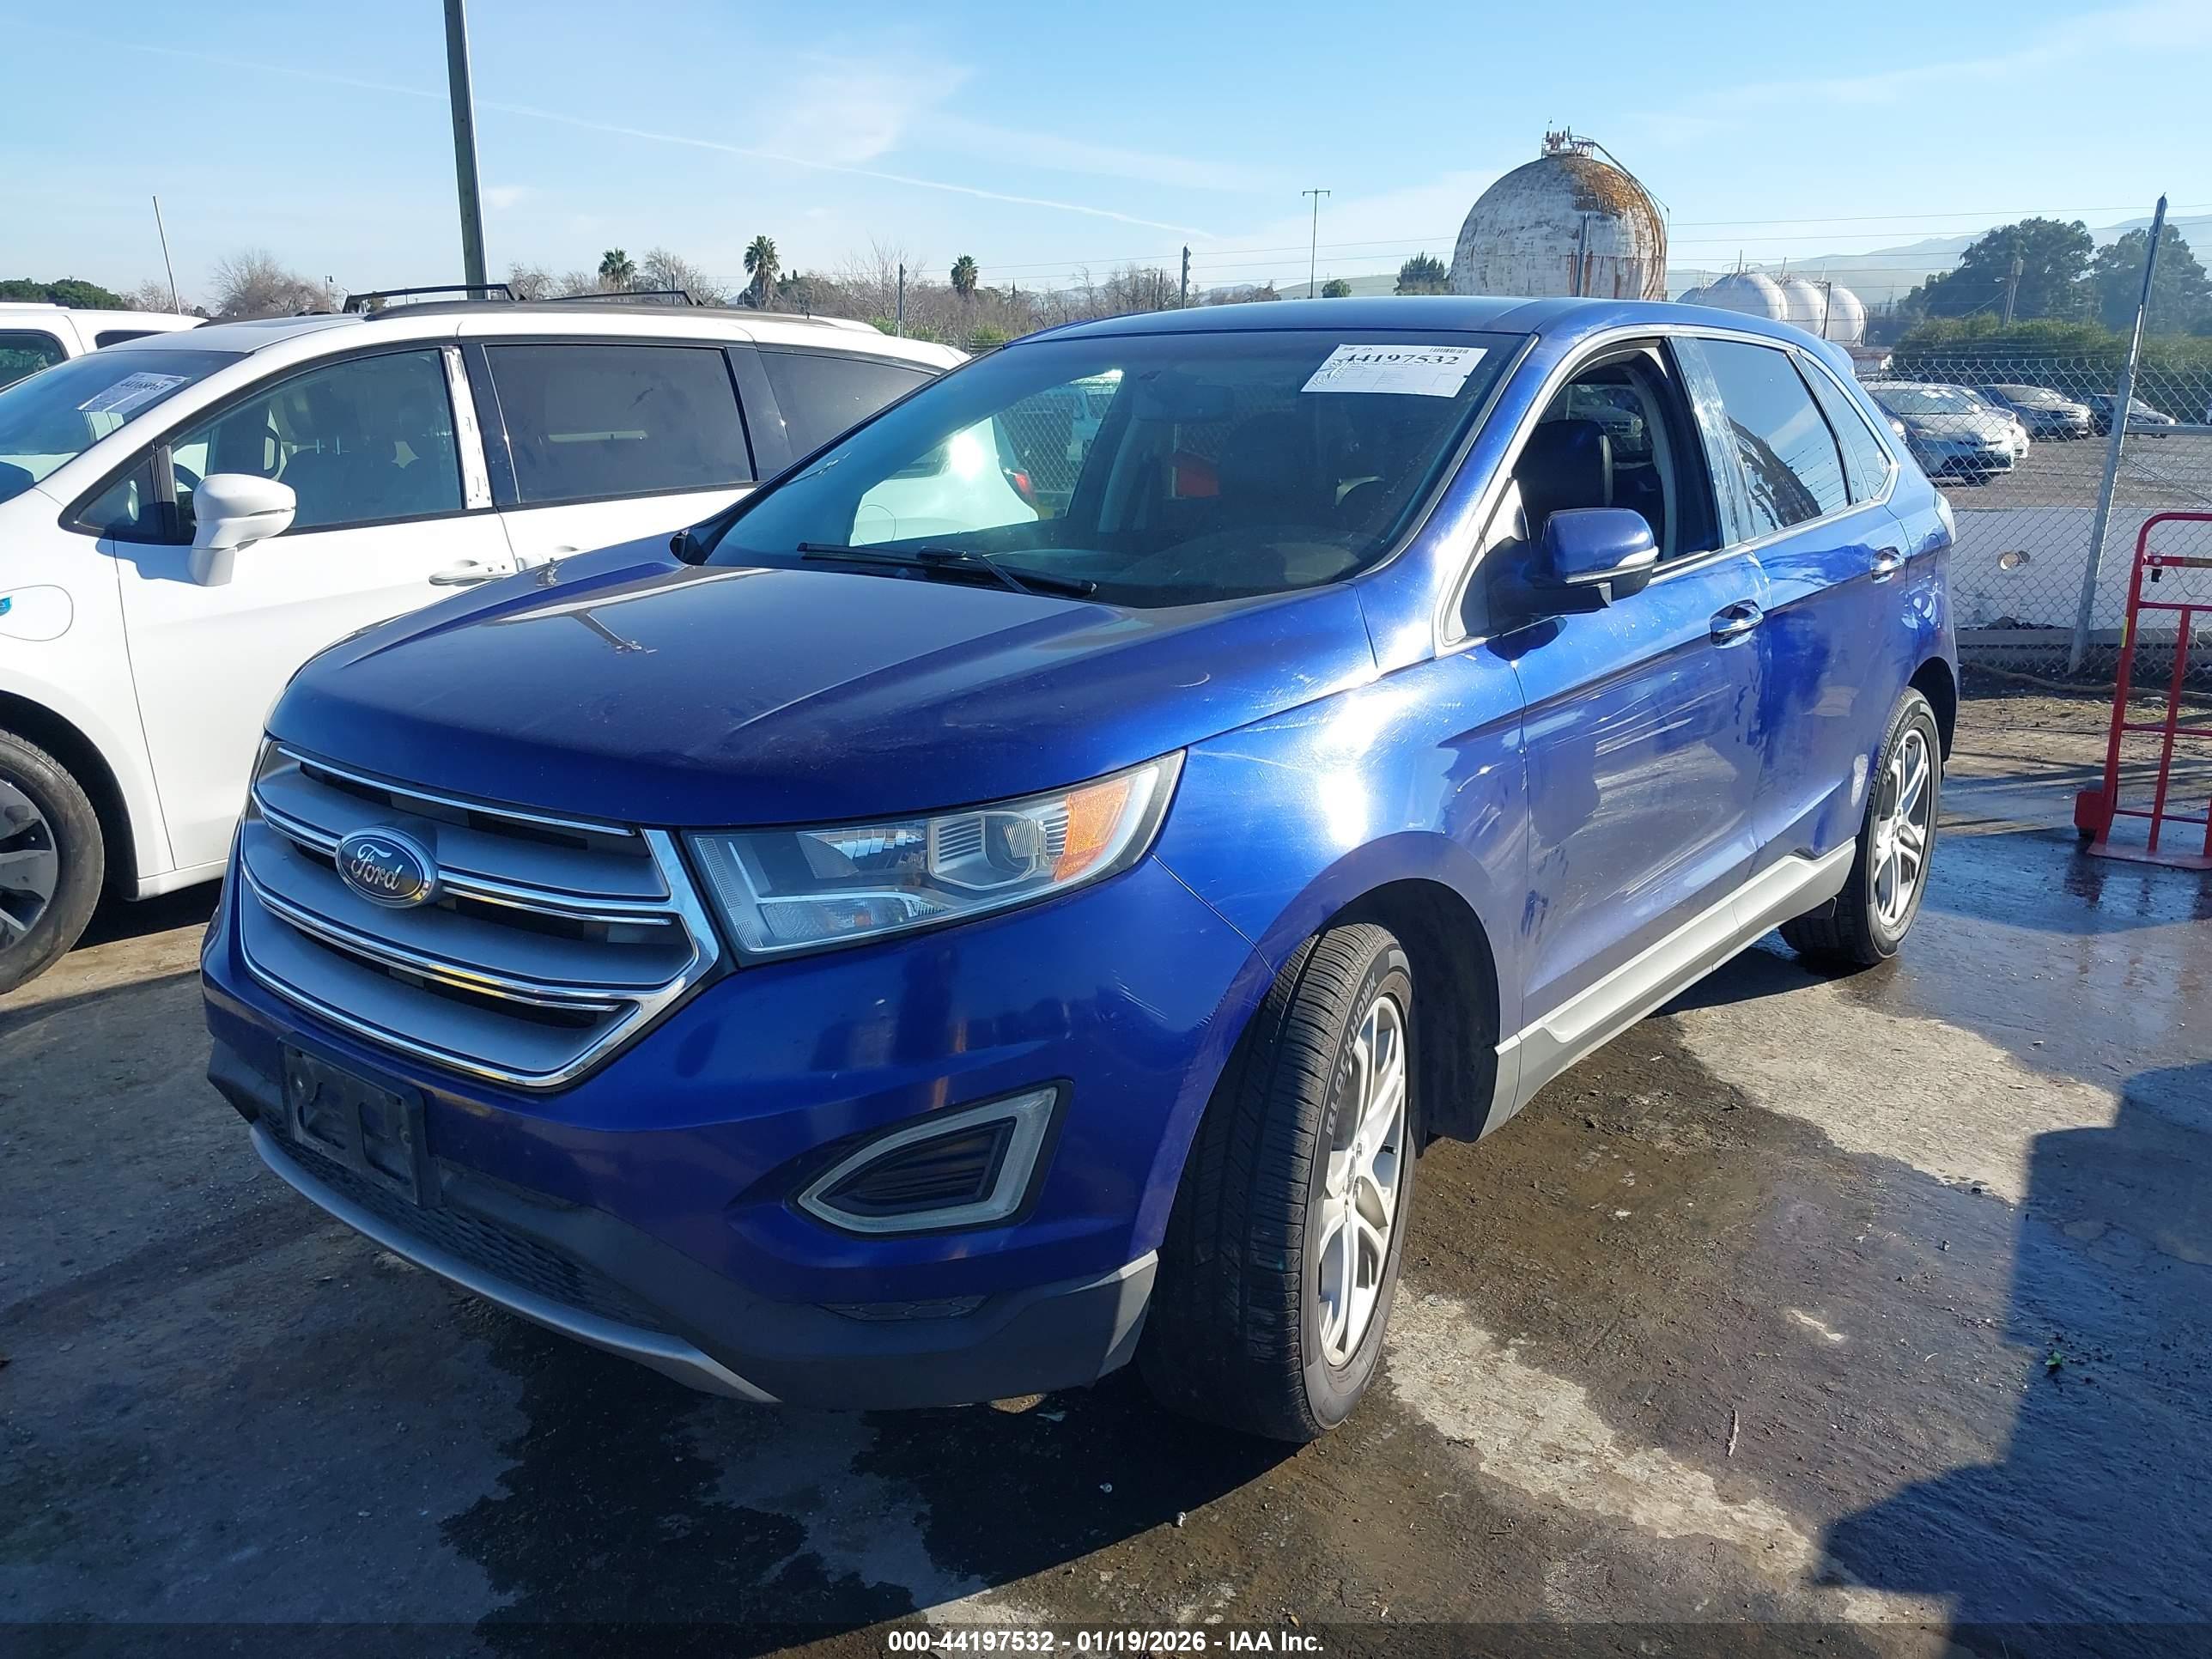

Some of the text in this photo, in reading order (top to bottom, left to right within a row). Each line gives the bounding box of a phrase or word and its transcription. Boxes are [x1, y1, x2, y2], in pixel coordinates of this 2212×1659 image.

[1340, 353, 1460, 366] 44197532
[350, 843, 404, 890] Ford
[1325, 971, 1377, 1136] BLACKHAWK
